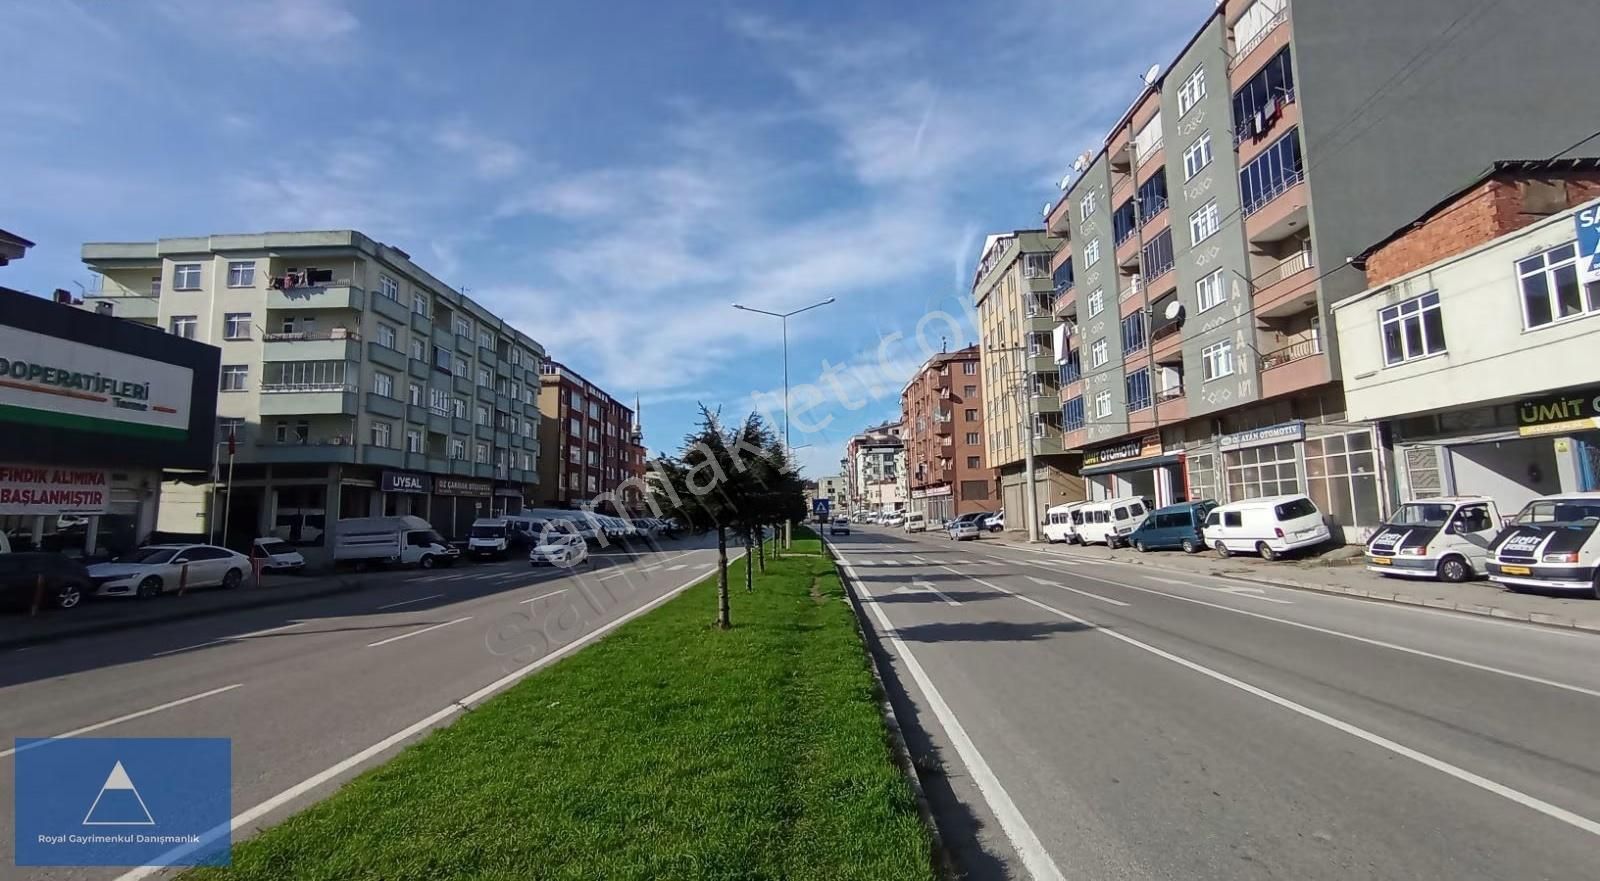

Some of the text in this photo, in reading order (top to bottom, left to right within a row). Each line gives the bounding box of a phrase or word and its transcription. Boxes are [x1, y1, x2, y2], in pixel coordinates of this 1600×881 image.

[1520, 397, 1584, 423] ÜMİT
[1, 467, 47, 483] FINDIK
[393, 476, 422, 489] UYSAL
[1, 488, 103, 506] BAŞLANMIŞTIR
